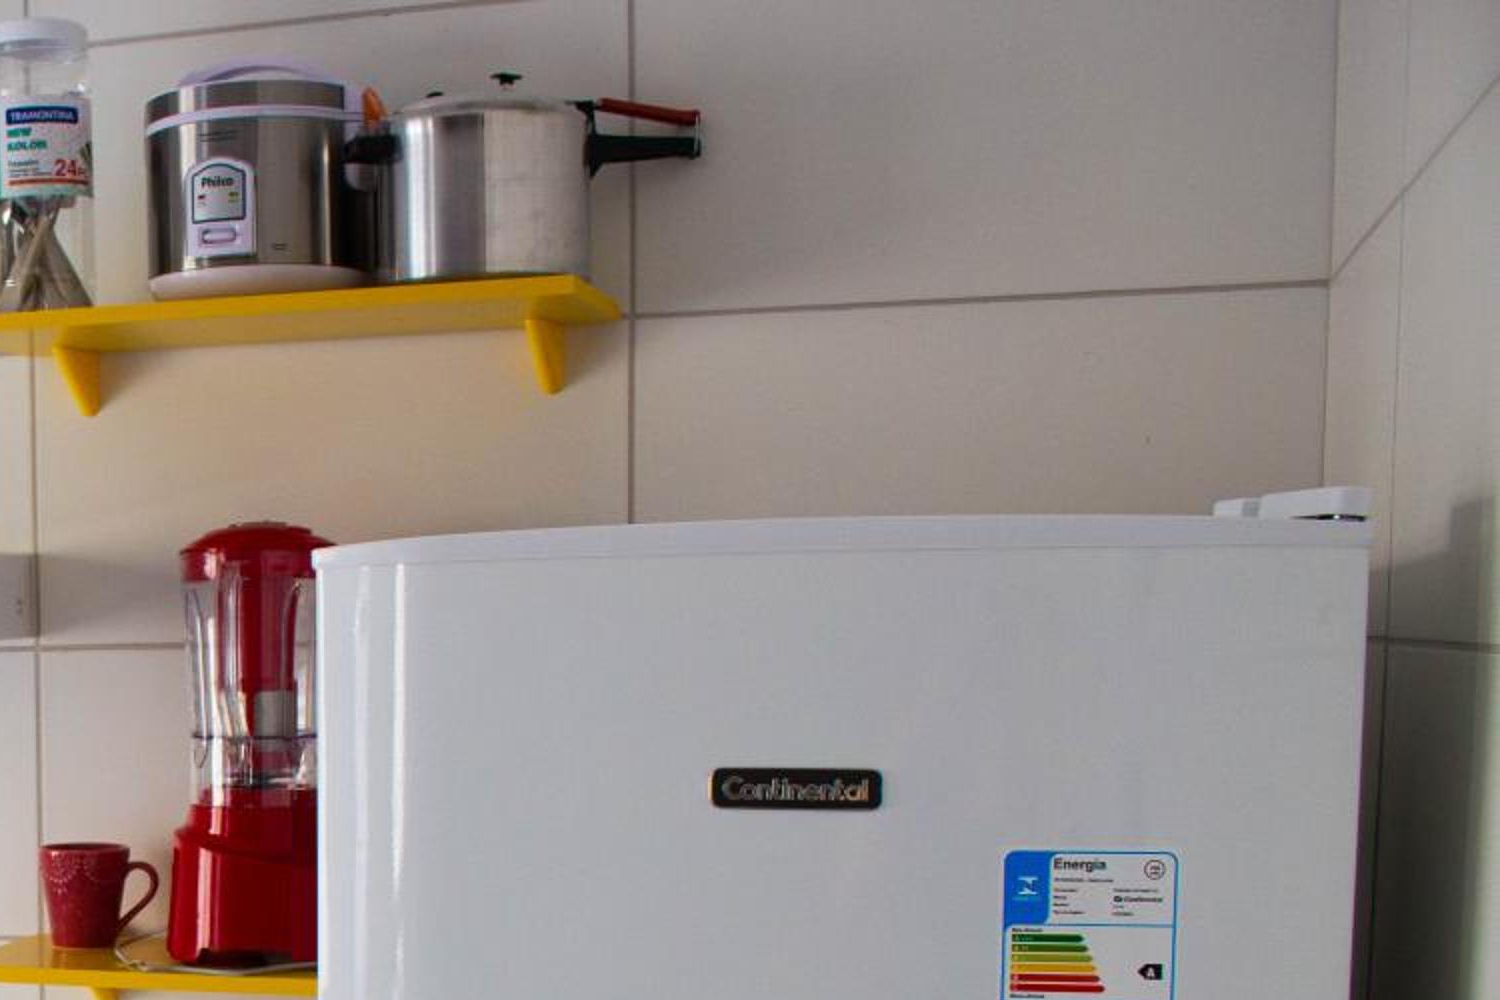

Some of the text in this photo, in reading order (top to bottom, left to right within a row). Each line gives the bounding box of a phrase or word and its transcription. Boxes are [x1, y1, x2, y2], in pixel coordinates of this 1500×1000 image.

[10, 109, 75, 121] TRAMONTINA
[201, 175, 235, 188] Philco
[721, 774, 870, 801] Continental
[1053, 857, 1107, 873] Energia
